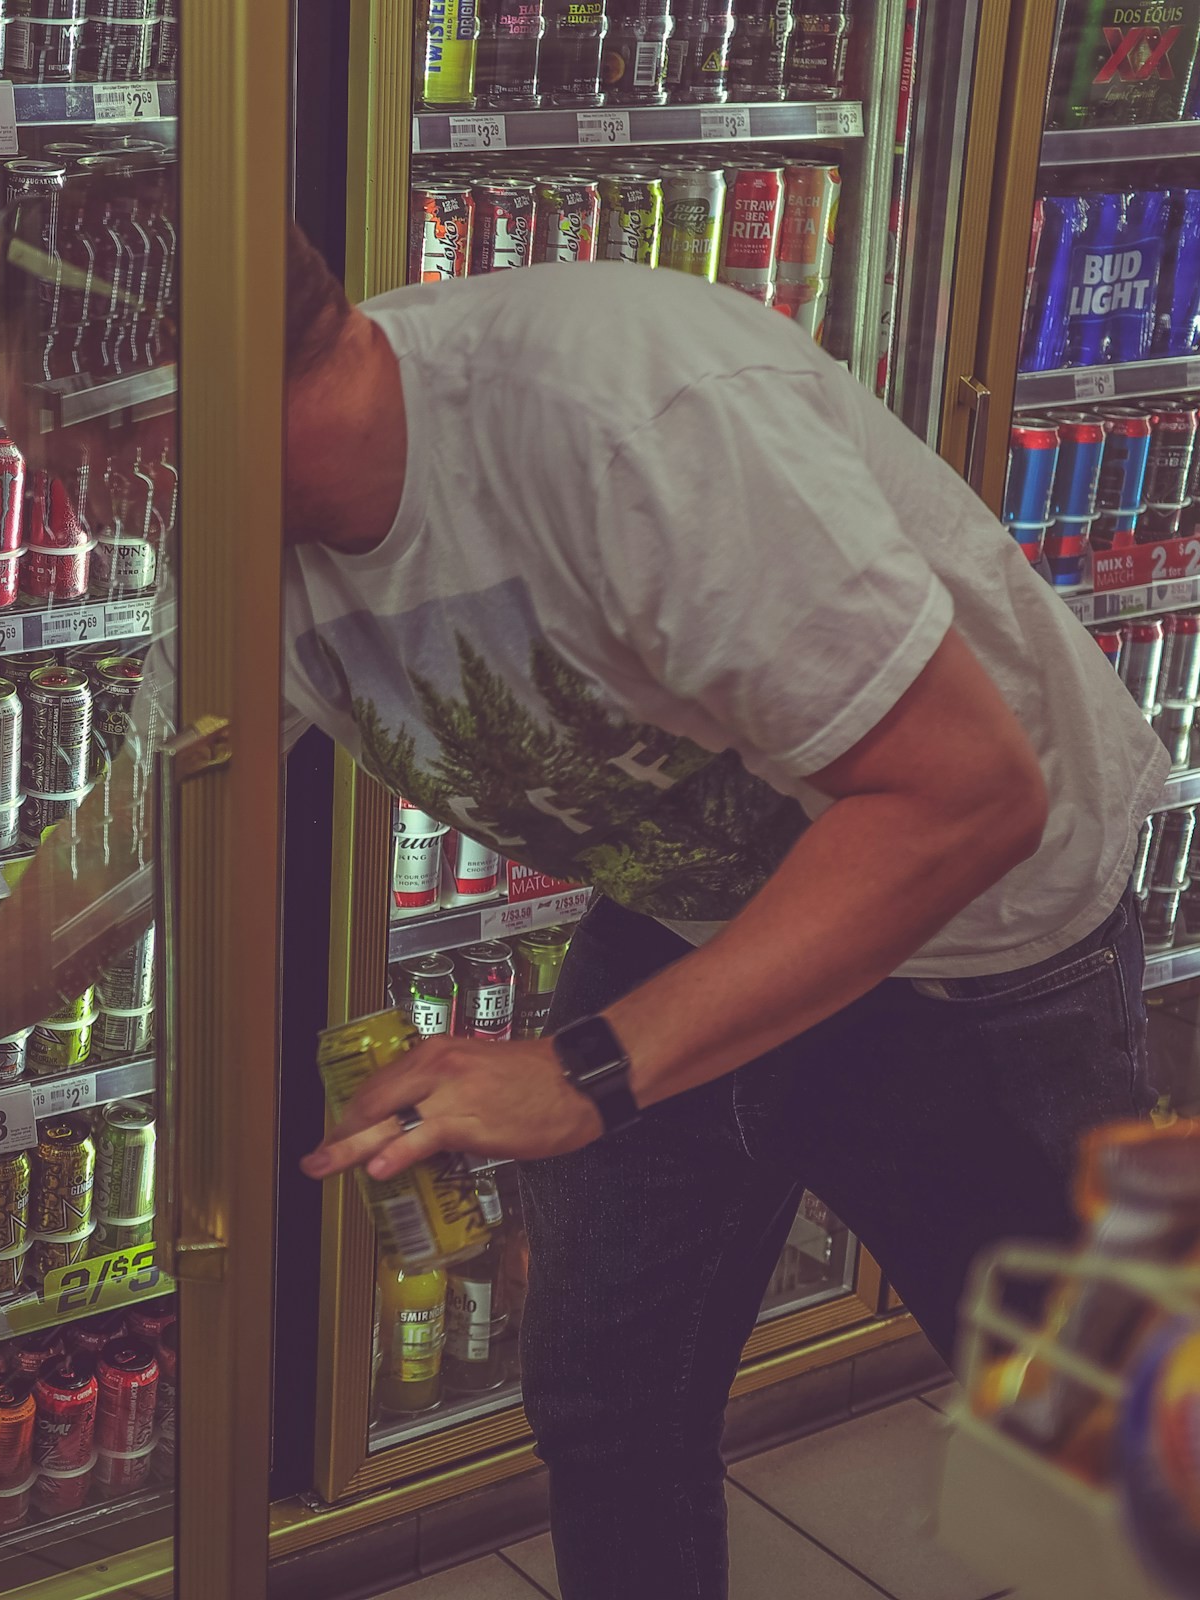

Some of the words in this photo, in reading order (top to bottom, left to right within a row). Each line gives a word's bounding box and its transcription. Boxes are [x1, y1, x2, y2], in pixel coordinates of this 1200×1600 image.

[1113, 8, 1142, 24] DOS
[1144, 6, 1184, 24] EQUIS
[673, 205, 705, 214] BUD
[734, 199, 776, 212] STRAW
[667, 212, 708, 222] LIGHT
[732, 222, 773, 240] RITA
[1083, 250, 1142, 285] BUD
[1069, 279, 1150, 316] LIGHT
[1097, 557, 1123, 572] MIX
[1125, 556, 1134, 568] &
[1097, 569, 1135, 585] MATCH
